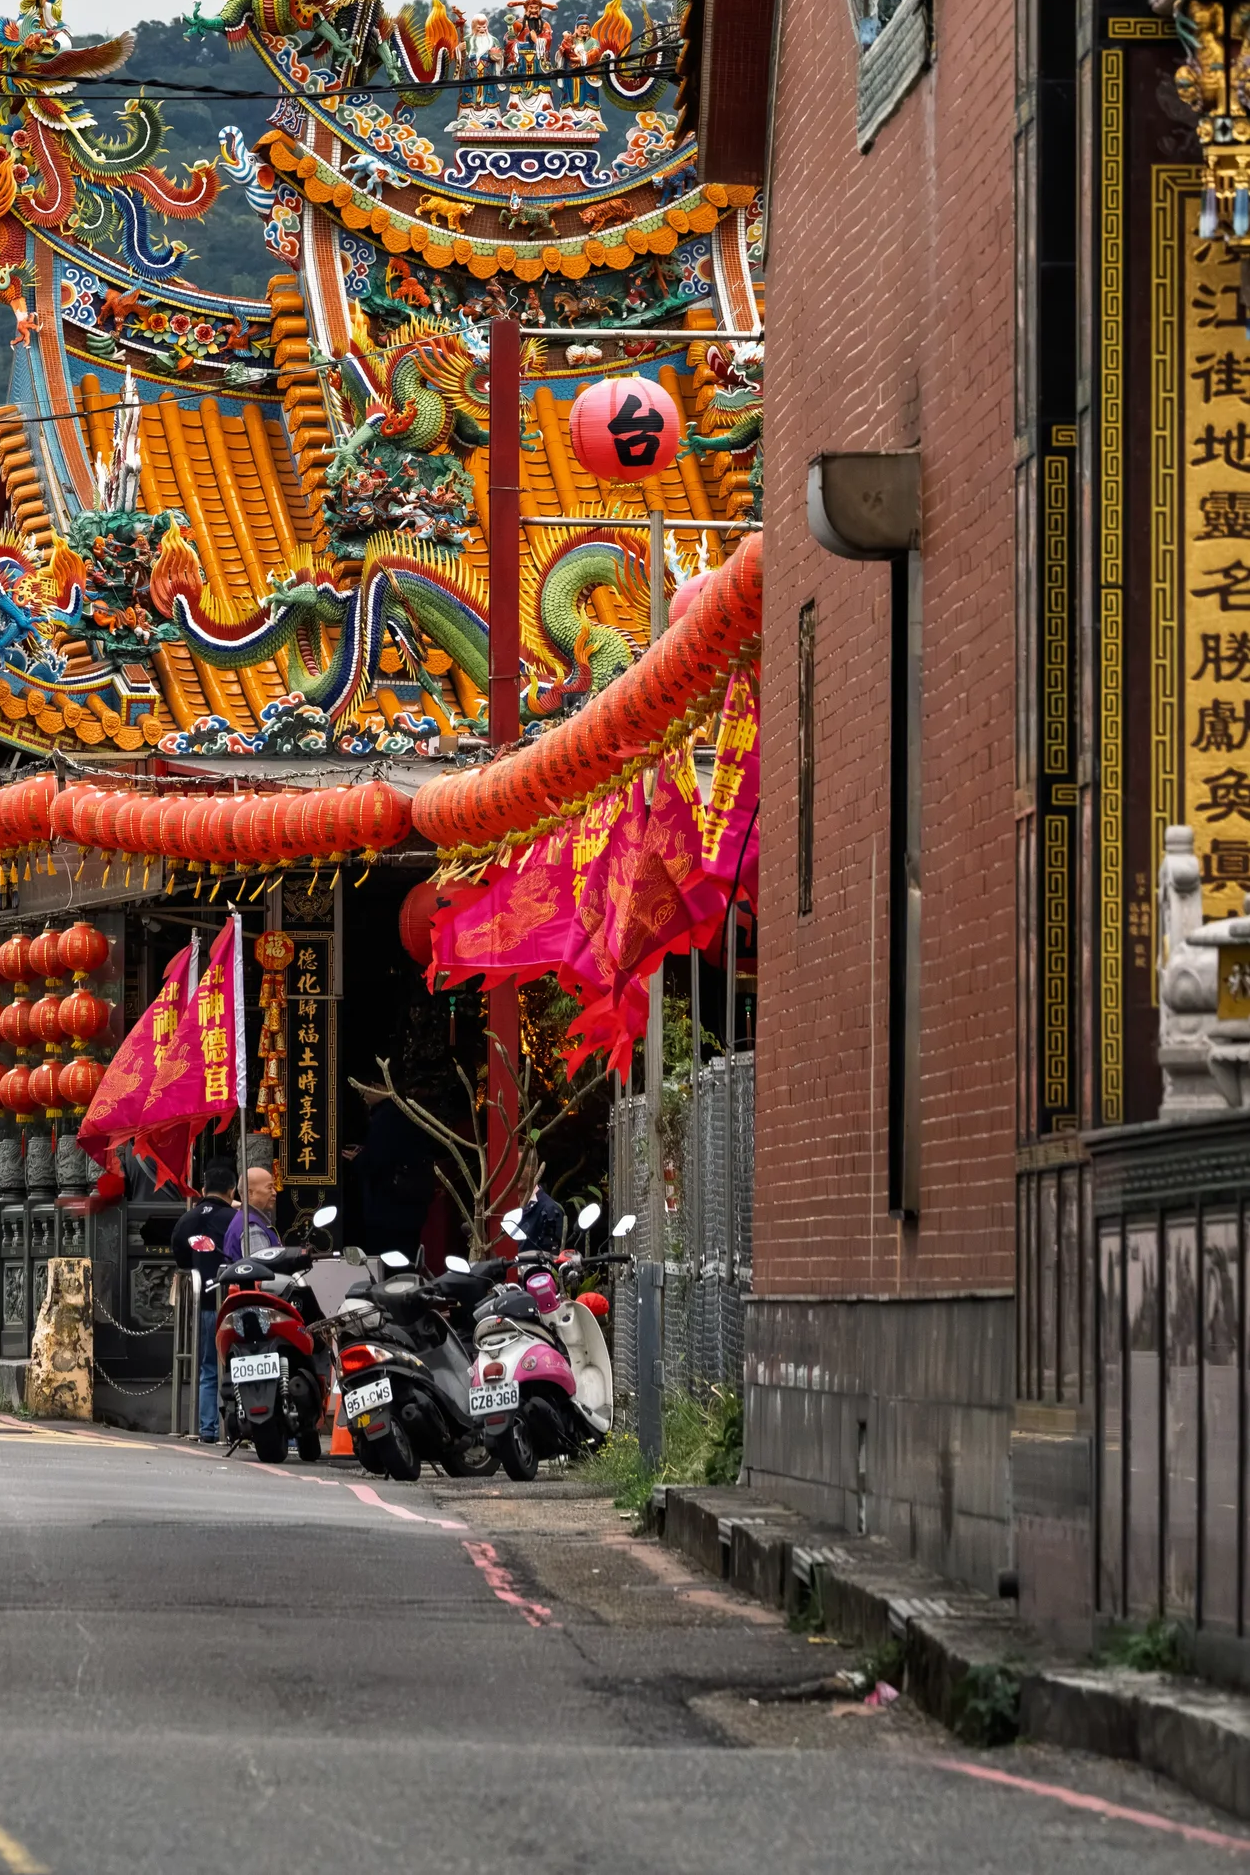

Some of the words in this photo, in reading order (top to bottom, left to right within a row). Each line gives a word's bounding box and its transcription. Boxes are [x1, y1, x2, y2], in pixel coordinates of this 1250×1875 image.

[607, 393, 665, 467] 台
[197, 988, 229, 1103] 神德宮
